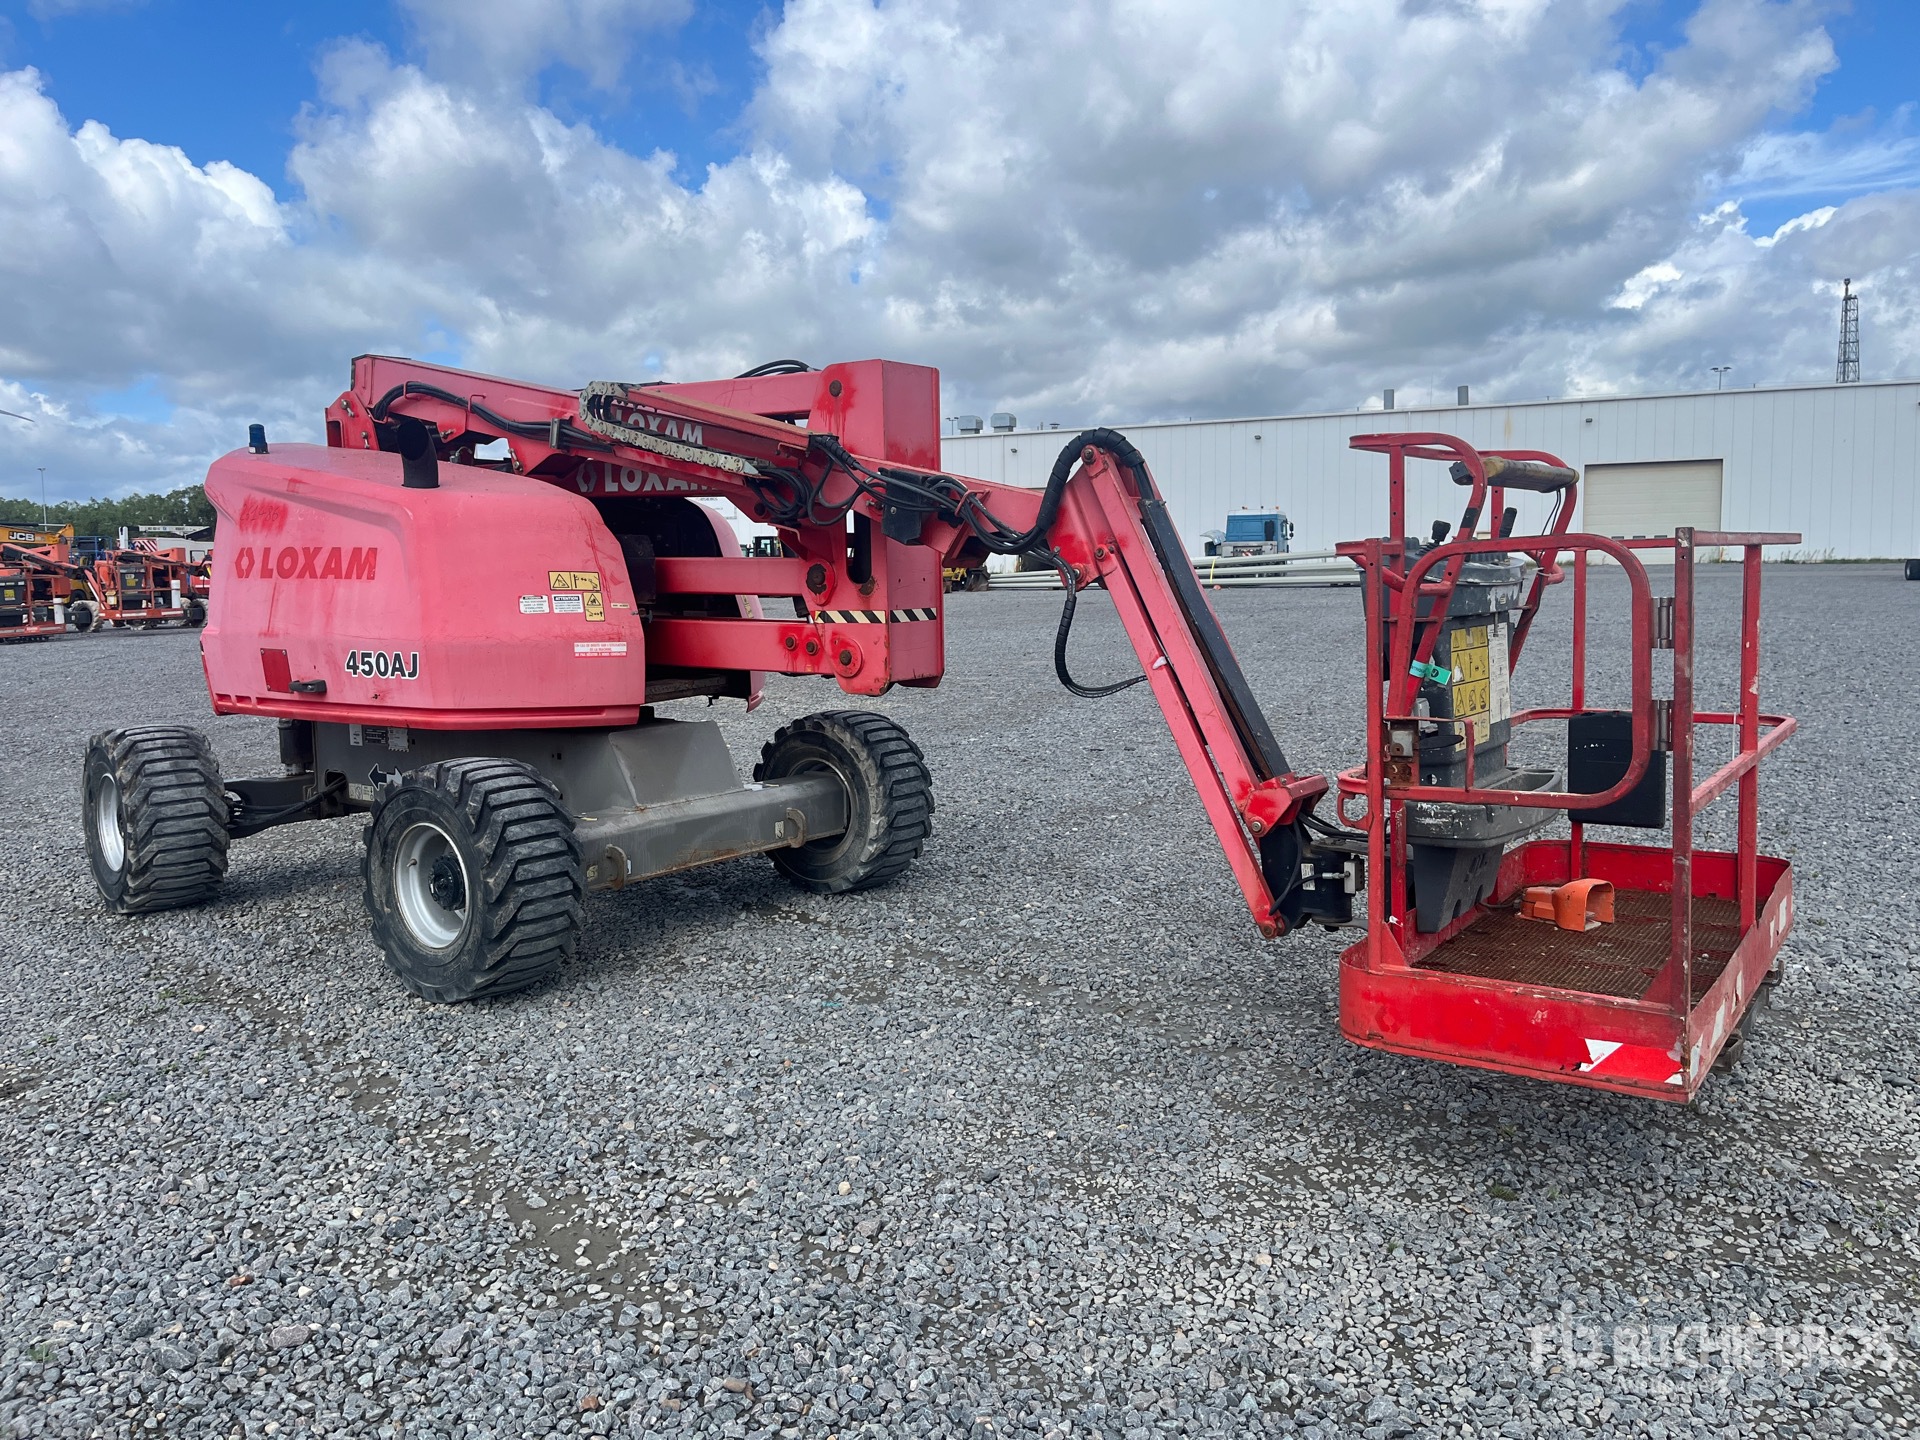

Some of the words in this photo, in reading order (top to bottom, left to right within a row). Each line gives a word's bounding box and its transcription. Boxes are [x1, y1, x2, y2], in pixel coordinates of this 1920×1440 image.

[605, 463, 718, 492] LOXA
[9, 532, 35, 541] JCB
[260, 547, 377, 580] LOXAM
[346, 650, 419, 679] 450AJ
